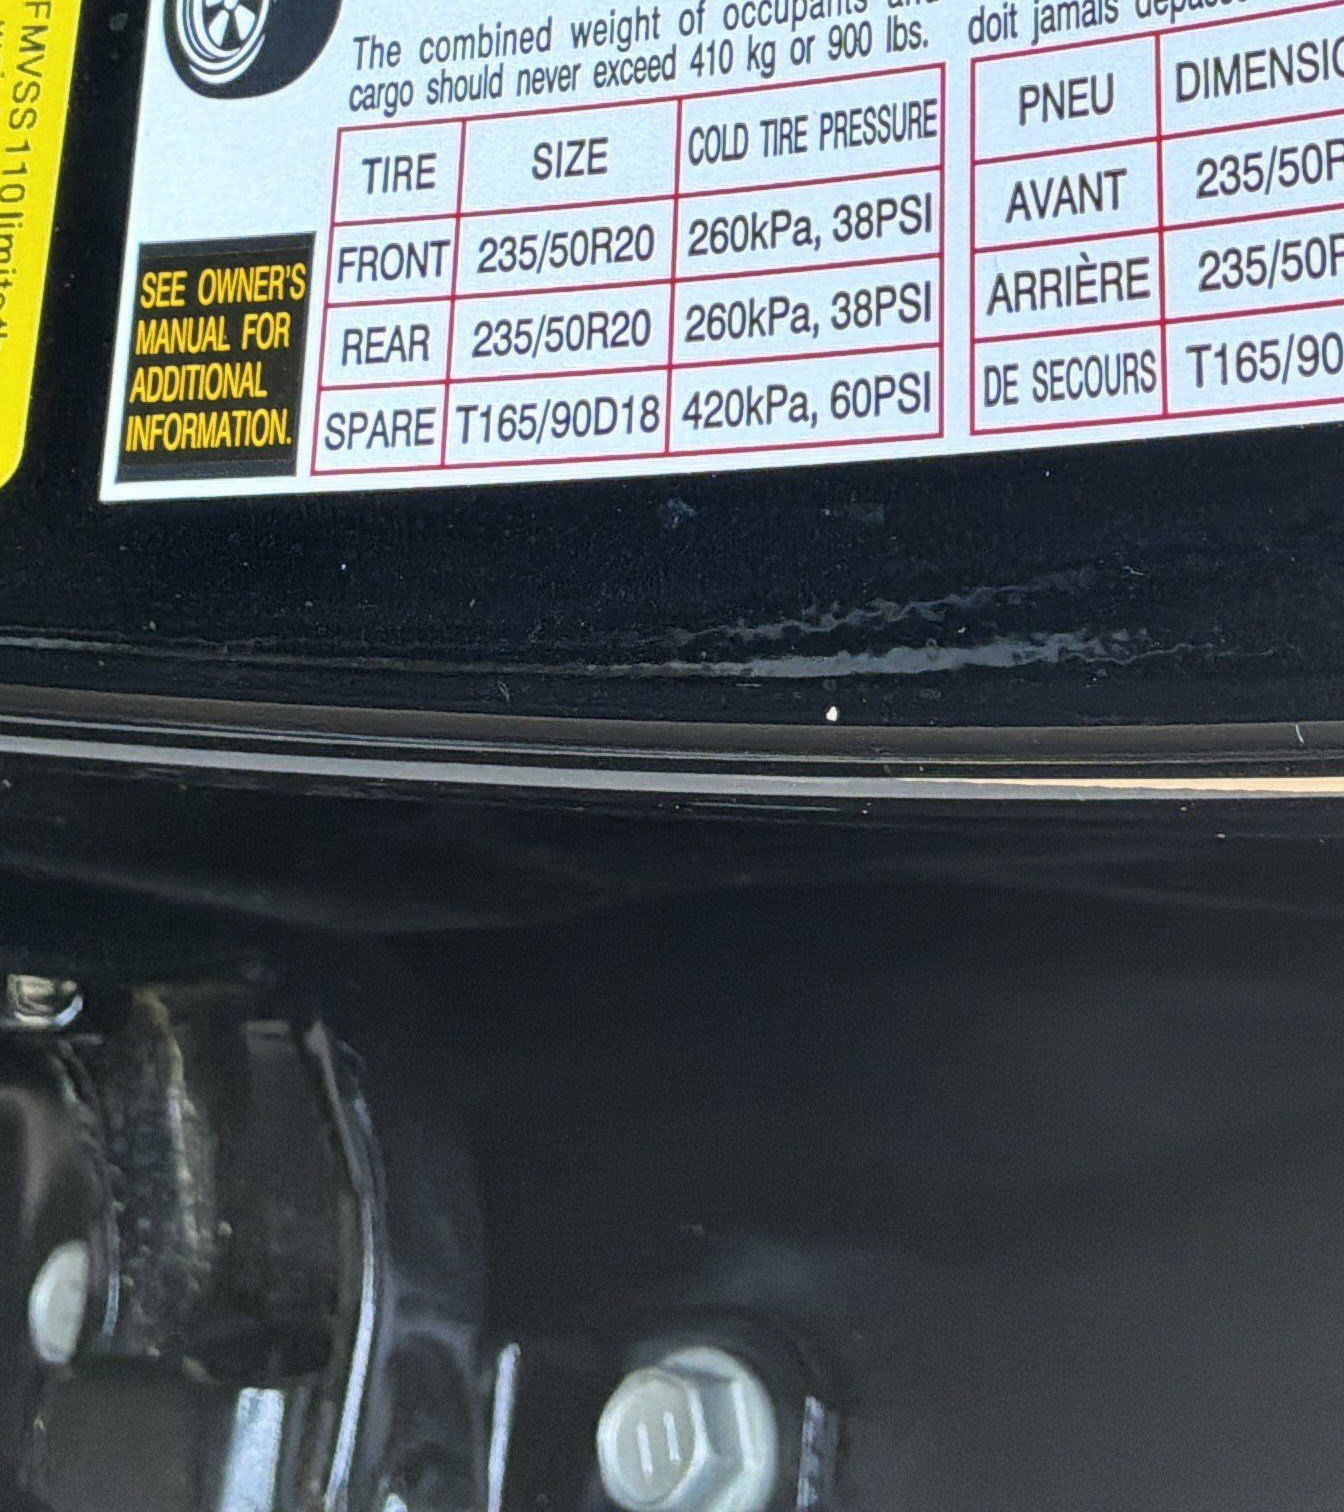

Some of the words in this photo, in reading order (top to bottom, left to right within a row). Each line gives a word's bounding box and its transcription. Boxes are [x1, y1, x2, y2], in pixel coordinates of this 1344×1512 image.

[352, 34, 401, 70] The
[418, 15, 552, 65] combined
[570, 5, 661, 49] weight
[967, 1, 1018, 45] doit
[7, 0, 51, 130] FMVSS
[348, 79, 414, 115] cargo
[425, 62, 504, 105] should
[516, 62, 581, 96] never
[593, 42, 676, 89] exceed
[689, 37, 733, 77] 410
[746, 35, 776, 78] kg
[789, 34, 815, 66] or
[827, 20, 872, 61] 900
[886, 14, 928, 52] lbs.
[1018, 72, 1114, 126] PNEU
[687, 121, 749, 166] COLD
[759, 114, 808, 157] TIRE
[818, 97, 937, 151] PRESSURE
[362, 152, 437, 194] TIRE
[531, 136, 608, 181] SIZE
[1004, 167, 1127, 223] AVANT
[476, 223, 654, 273] 235/50R20
[687, 208, 821, 256] 260kPa,
[832, 192, 931, 242] 38PSI
[139, 270, 187, 308] SEE
[197, 262, 306, 305] OWNER'S
[336, 238, 451, 283] FRONT
[684, 295, 819, 342] 260kPa,
[830, 280, 931, 330] 38PSI
[986, 256, 1151, 316] ARRIÈRE
[134, 315, 230, 355] MANUAL
[241, 311, 291, 350] FOR
[341, 323, 430, 366] REAR
[471, 308, 651, 358] 235/50R20
[128, 360, 268, 403] ADDITIONAL
[681, 383, 817, 430] 420kPa,
[829, 370, 930, 420] 60PSI
[983, 362, 1019, 407] DE
[1031, 348, 1157, 403] SECOURS
[125, 407, 291, 451] INFORMATION.
[324, 406, 436, 451] SPARE
[455, 394, 659, 444] T165/90D18
